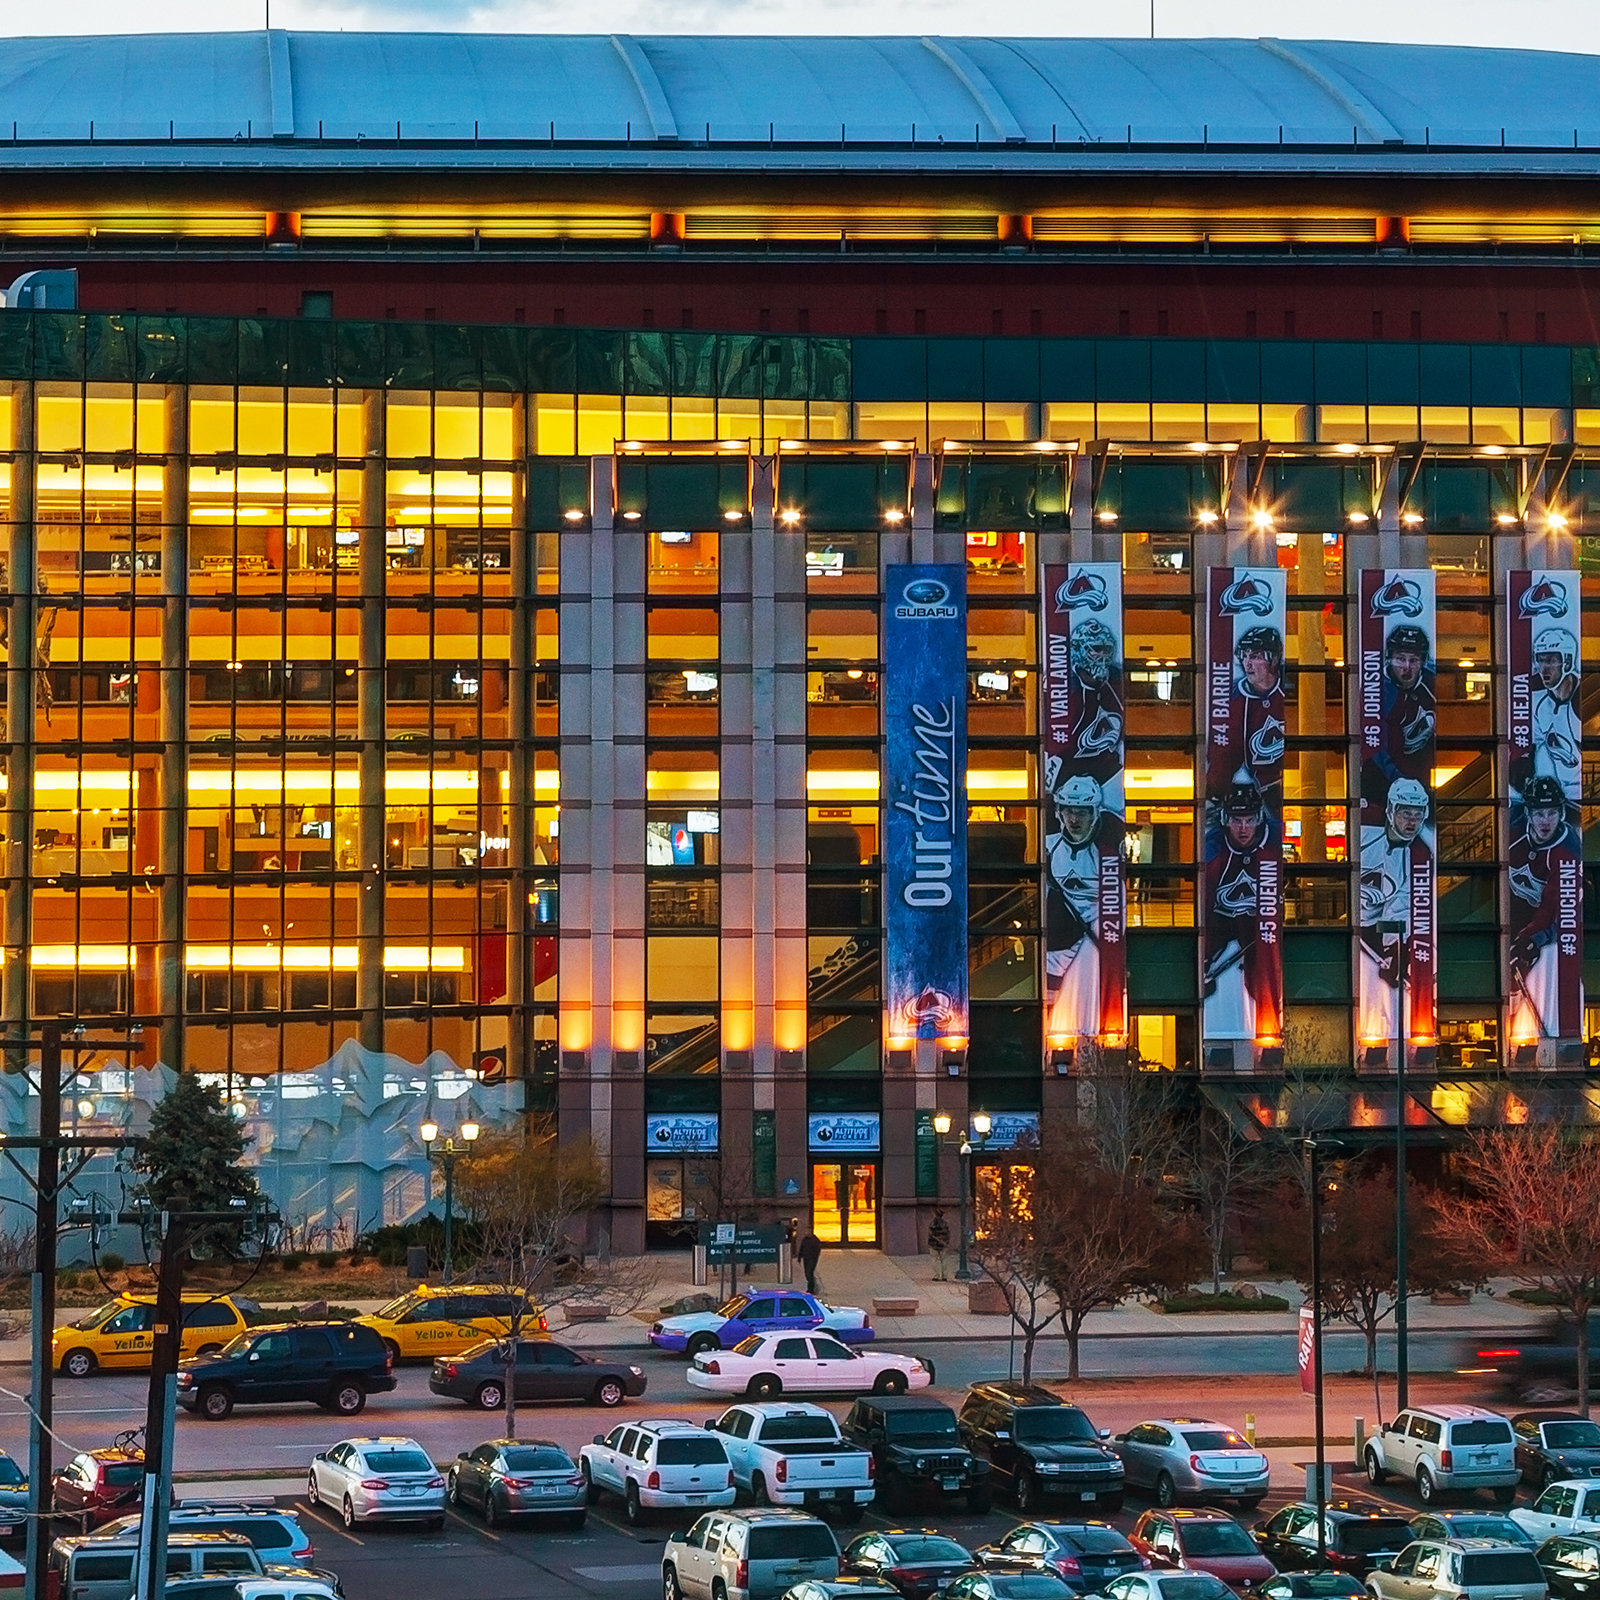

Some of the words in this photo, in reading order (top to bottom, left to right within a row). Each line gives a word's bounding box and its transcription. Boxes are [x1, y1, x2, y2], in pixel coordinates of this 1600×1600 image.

[896, 607, 956, 618] SUBARU
[1049, 633, 1069, 719] VARLAMOV
[1212, 661, 1230, 719] BARRIE
[1364, 650, 1381, 719] JOHNSON
[1513, 673, 1529, 720] HEJDA
[1051, 722, 1069, 743] #1
[1213, 724, 1229, 746] #4
[1365, 725, 1381, 747] #6
[1514, 725, 1529, 748] #8
[894, 699, 953, 825] time
[903, 831, 952, 907] Our
[1102, 856, 1119, 915] HOLDEN
[1260, 860, 1278, 917] GUENIN
[1413, 860, 1430, 935] MITCHELL
[1560, 859, 1576, 930] DUCHENE
[1103, 919, 1119, 943] #2
[1260, 922, 1277, 944] #5
[1561, 934, 1577, 955] #9
[1413, 939, 1430, 962] #7
[415, 1329, 454, 1340] Yellow
[457, 1328, 479, 1338] Cab
